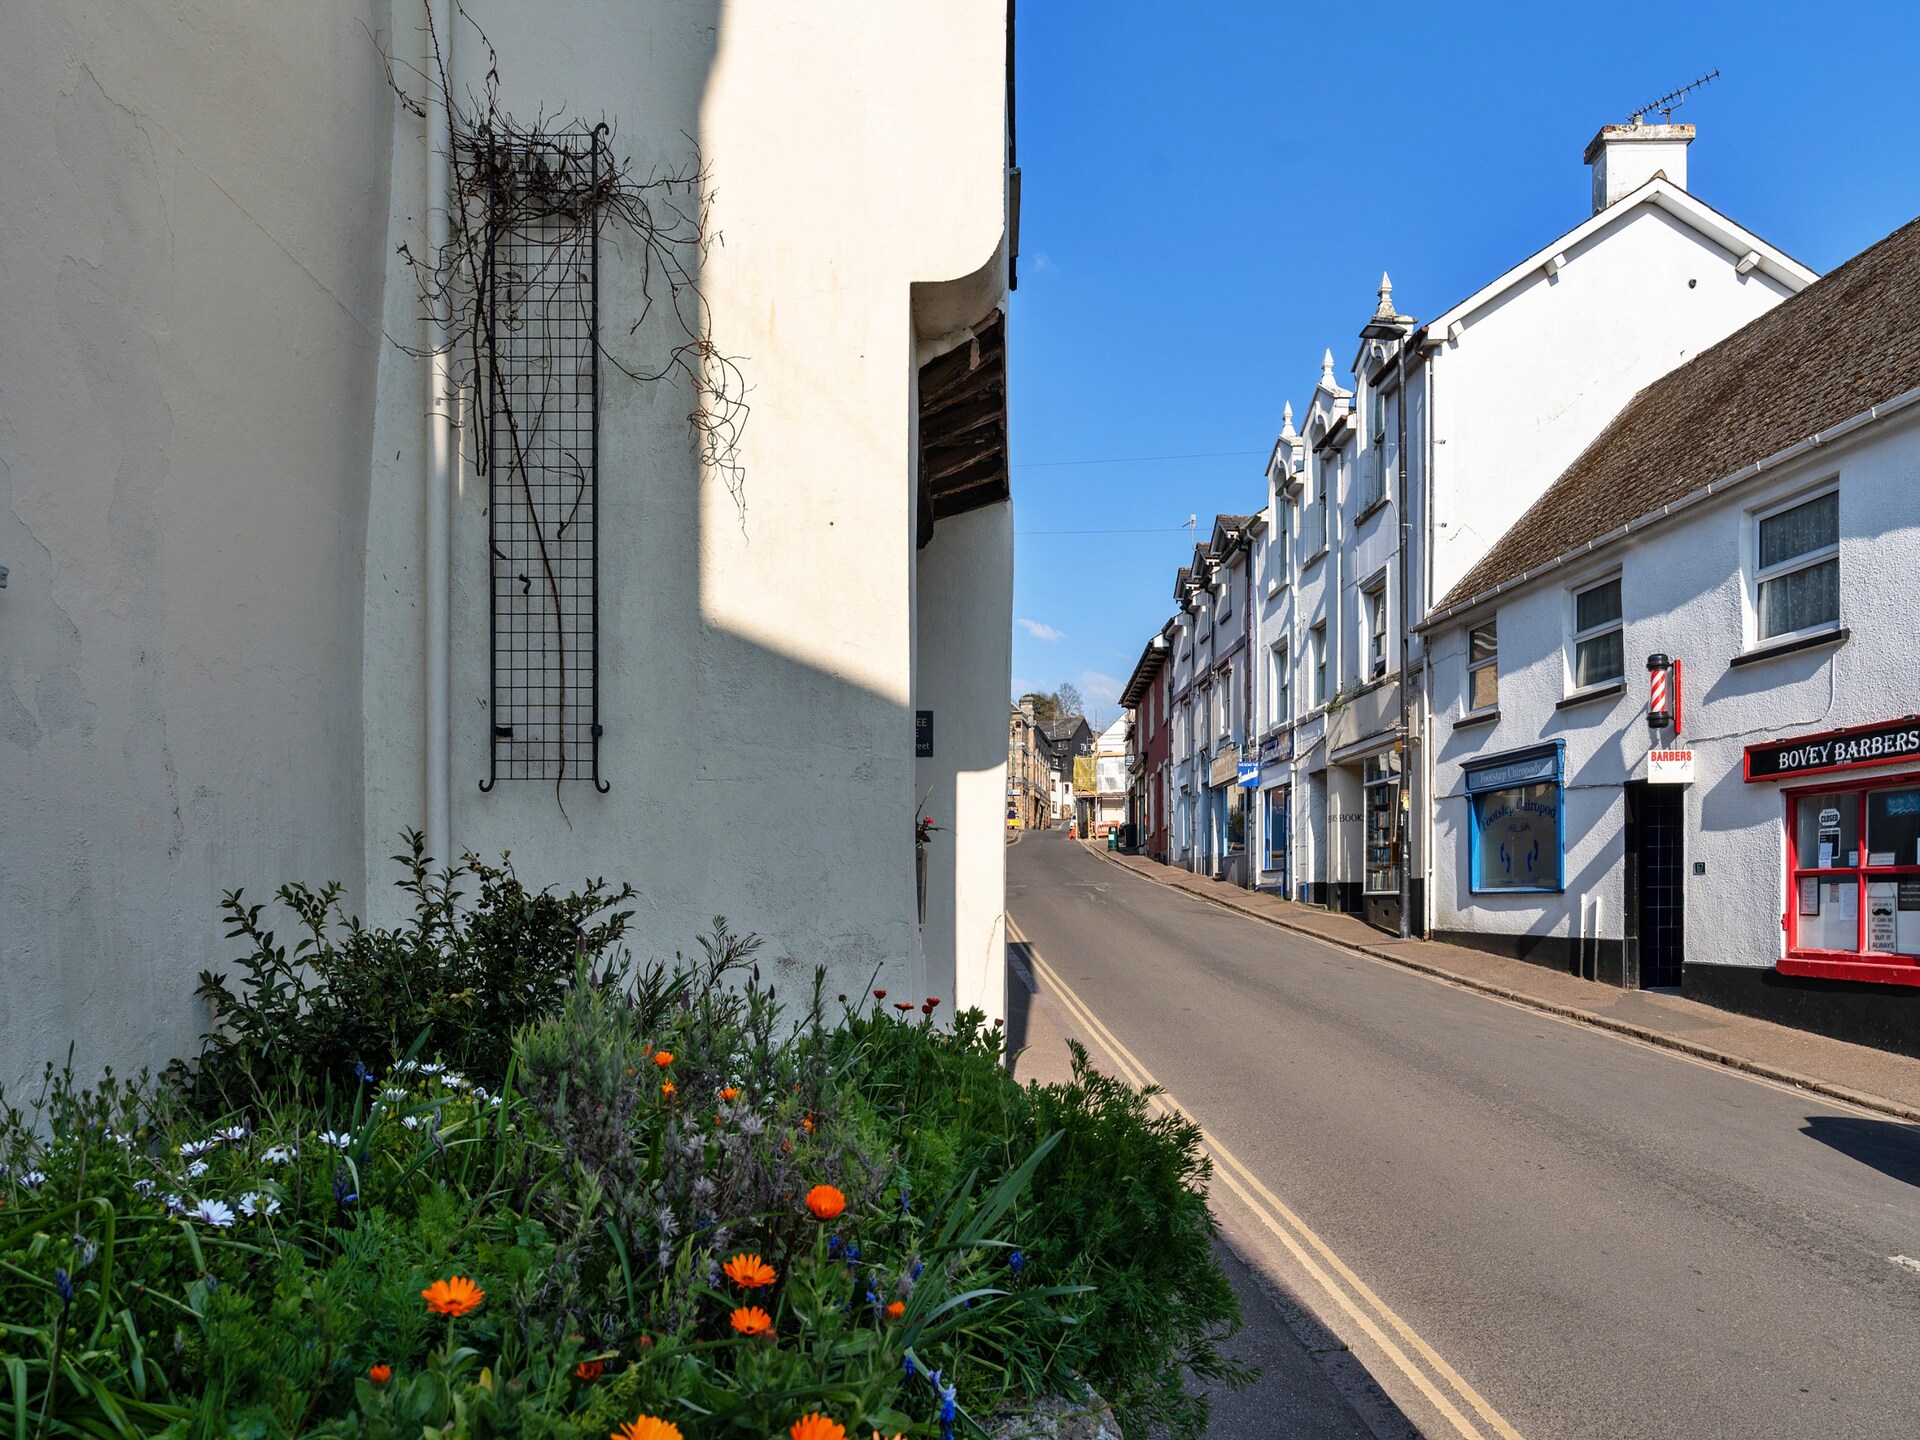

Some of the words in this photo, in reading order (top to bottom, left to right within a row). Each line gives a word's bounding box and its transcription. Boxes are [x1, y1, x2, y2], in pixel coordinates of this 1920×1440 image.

[1651, 751, 1692, 762] BARBERS
[1778, 740, 1832, 770] BOVEY
[1834, 730, 1920, 761] BARBERS
[1480, 771, 1507, 784] Footstep
[1507, 762, 1541, 779] Chiropody
[1481, 805, 1514, 832] Footstep
[1820, 814, 1839, 823] CLOSED
